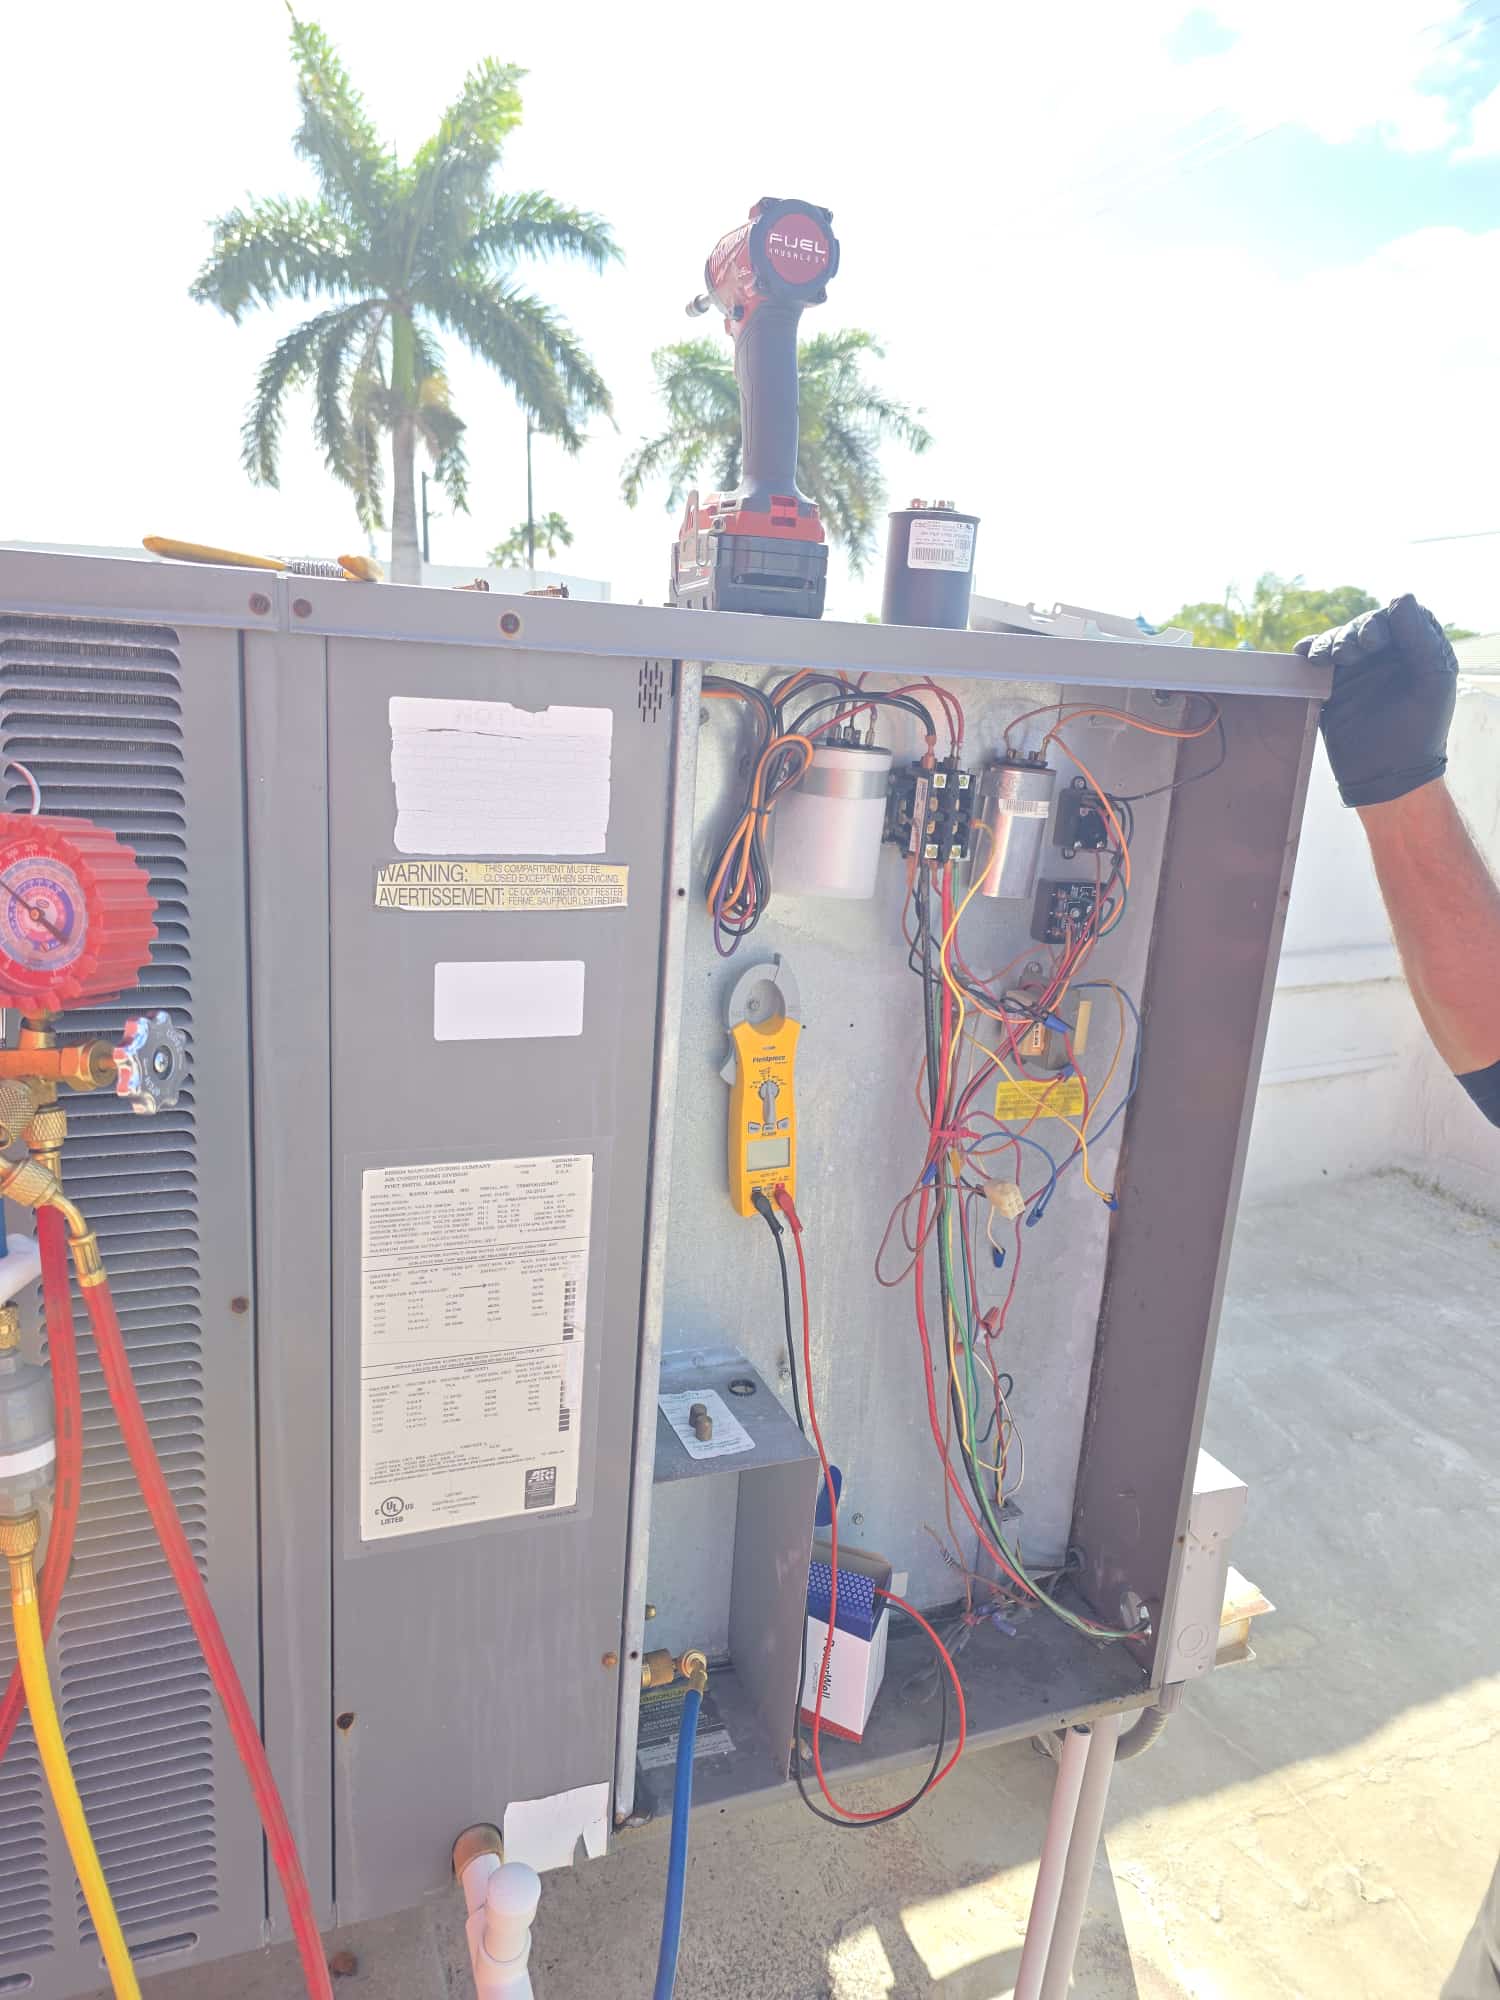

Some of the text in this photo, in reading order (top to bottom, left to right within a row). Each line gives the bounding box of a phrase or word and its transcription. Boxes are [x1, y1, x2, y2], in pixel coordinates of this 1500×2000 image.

[769, 233, 827, 254] FUEL
[380, 864, 469, 883] WARNING:
[483, 873, 518, 883] CLOSED
[520, 873, 550, 883] EXCEPT
[552, 874, 577, 884] WHEN
[485, 864, 601, 874] THIS COMPARTMENT MUST BE
[379, 887, 505, 906] AVERTISSEMENT:
